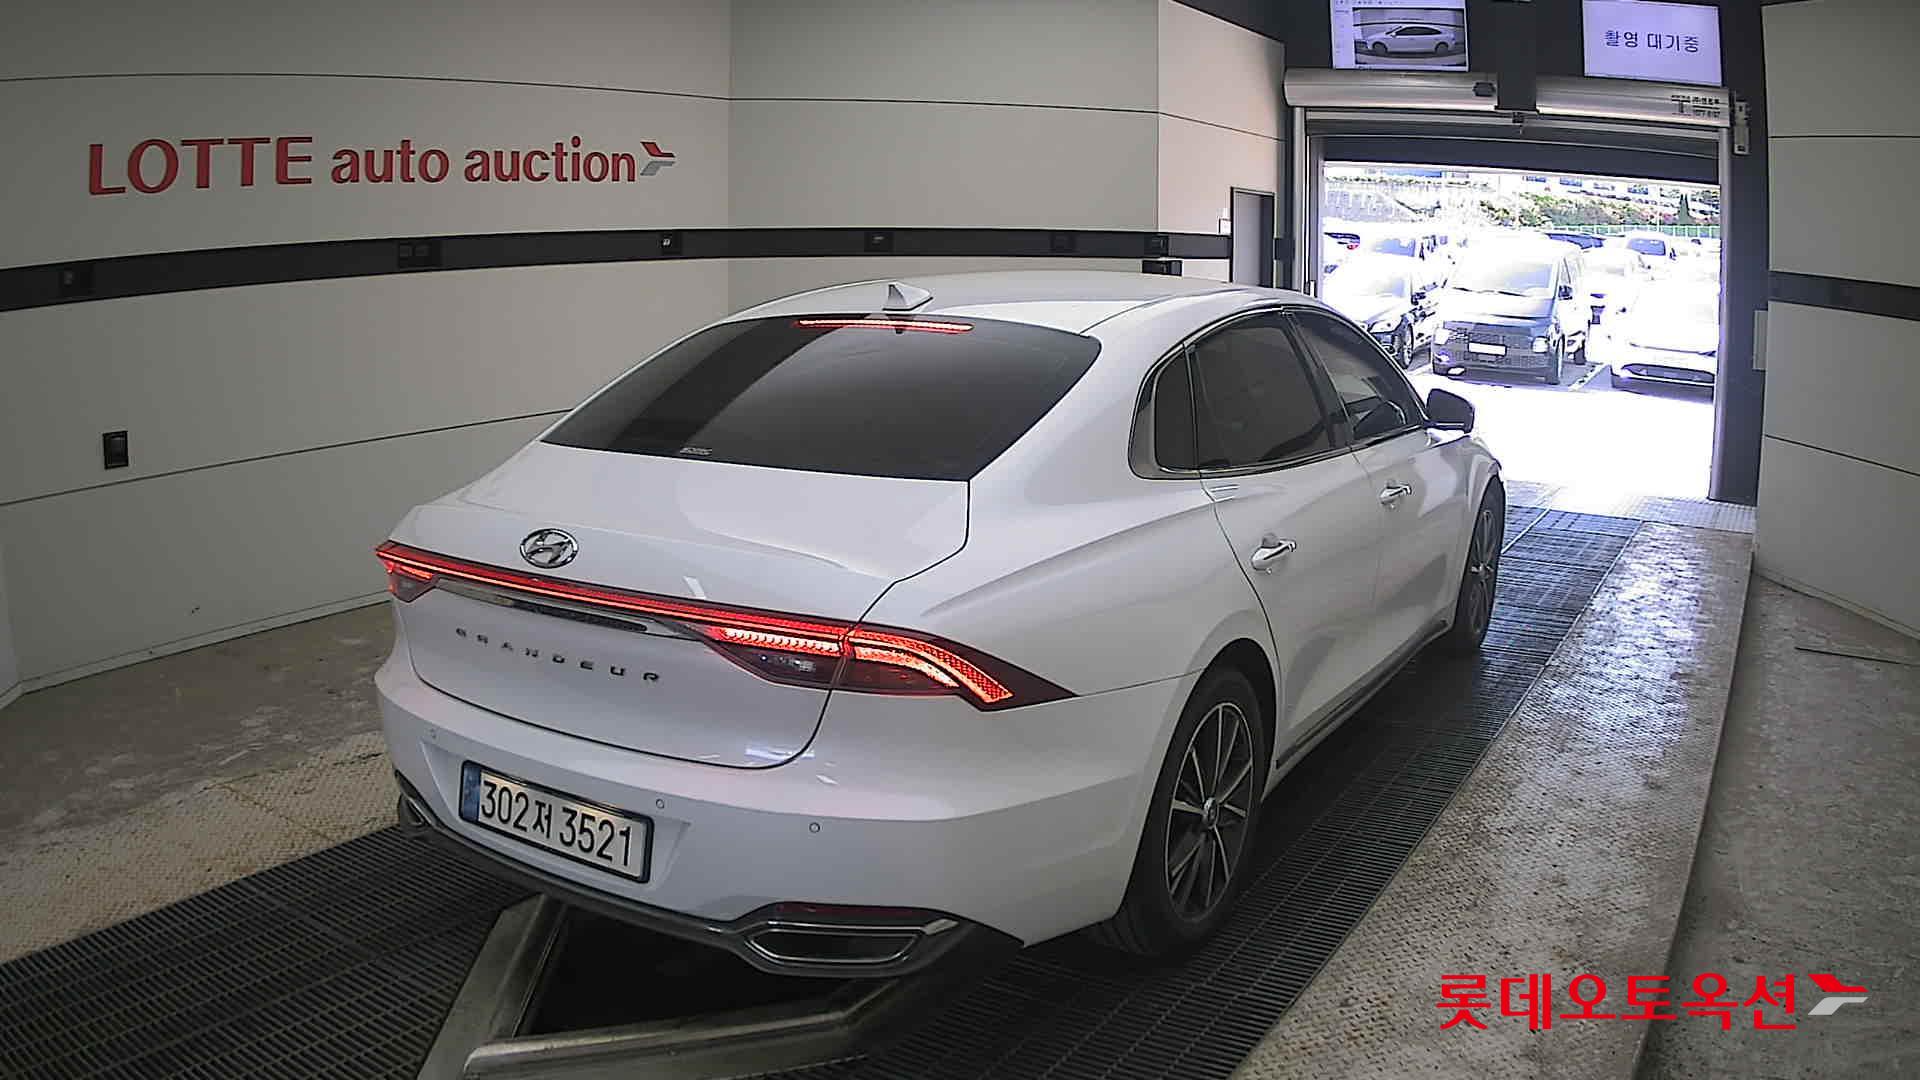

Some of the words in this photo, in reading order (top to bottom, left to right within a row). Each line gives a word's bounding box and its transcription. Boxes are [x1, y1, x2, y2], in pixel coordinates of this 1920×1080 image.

[1604, 29, 1638, 48] 촬영
[1647, 33, 1699, 53] 대기중
[88, 136, 313, 195] LOTTE
[331, 138, 449, 185] auto
[463, 135, 637, 184] auction
[455, 627, 660, 682] GRANDEUR
[559, 806, 632, 866] 3521
